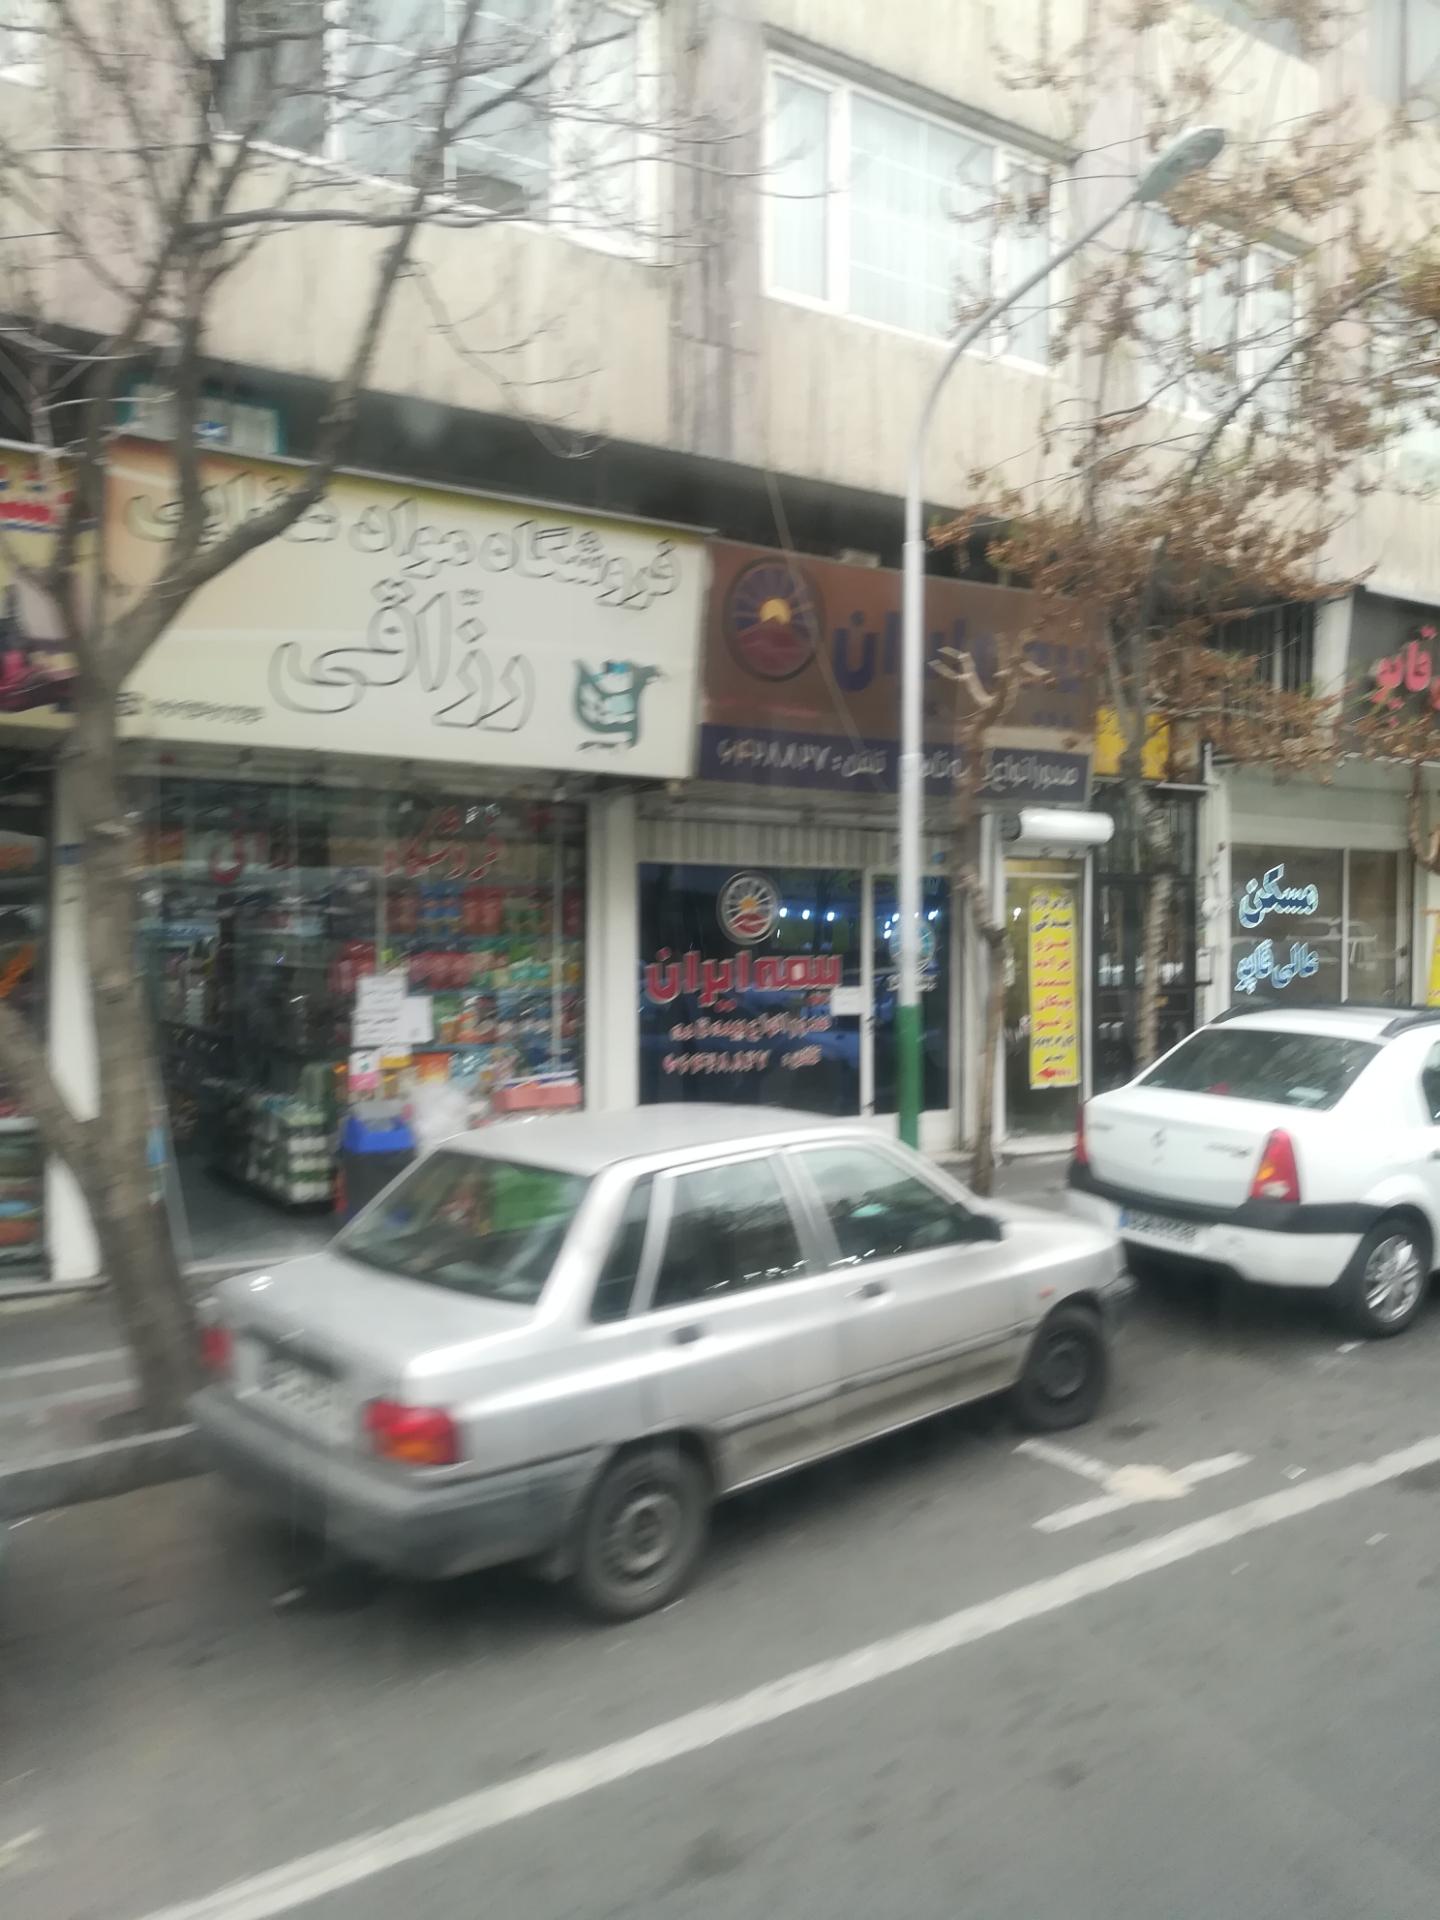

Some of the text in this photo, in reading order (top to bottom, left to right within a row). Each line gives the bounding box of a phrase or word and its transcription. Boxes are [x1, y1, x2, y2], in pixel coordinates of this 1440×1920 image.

[480, 518, 682, 610] فروشگاه
[1238, 863, 1319, 929] مسکن
[644, 946, 752, 1013] ایران
[1272, 942, 1319, 989] عالی
